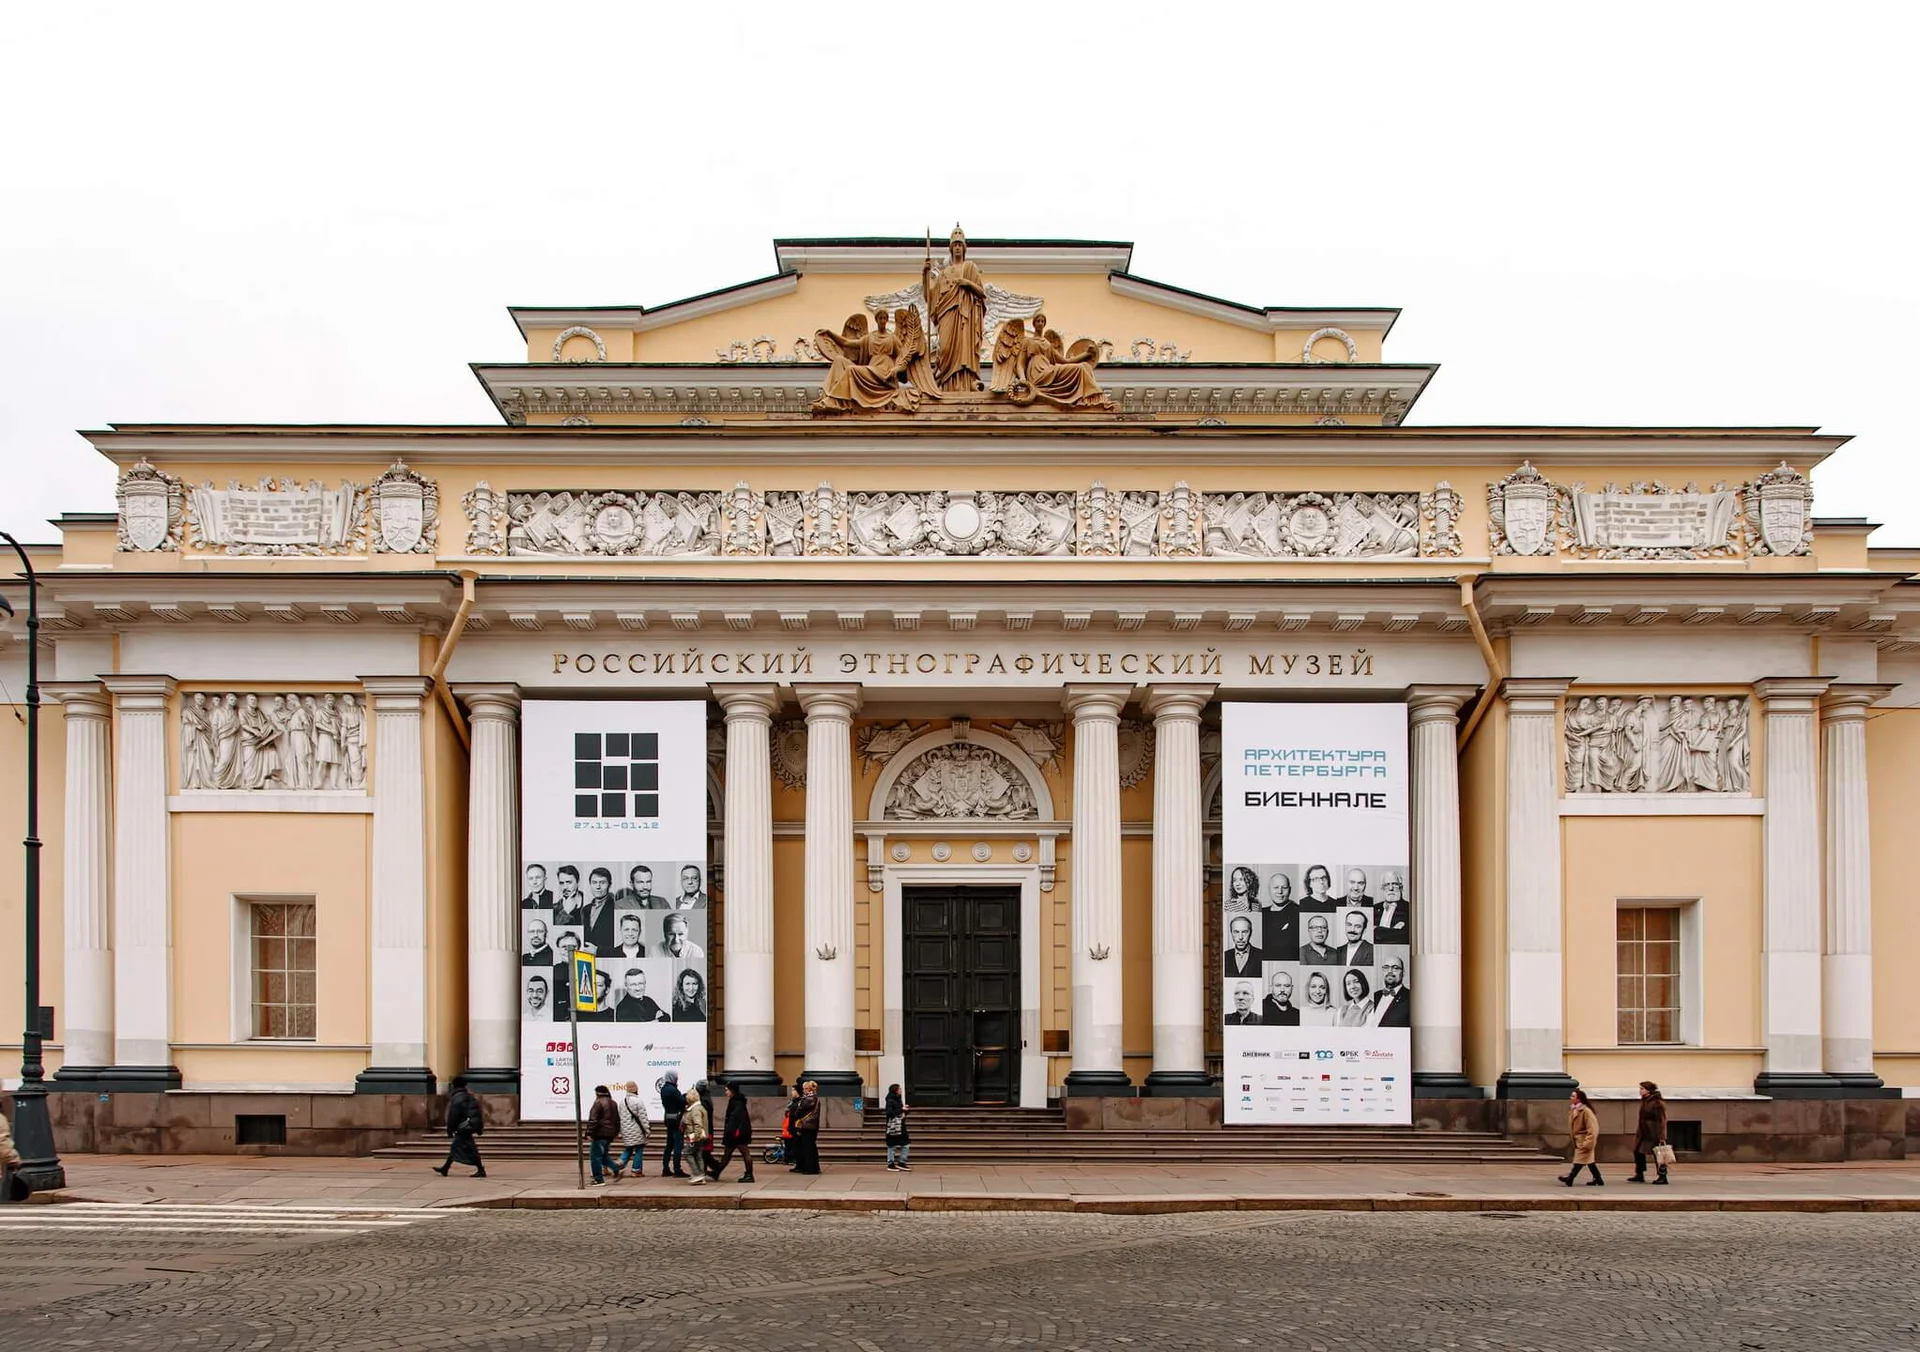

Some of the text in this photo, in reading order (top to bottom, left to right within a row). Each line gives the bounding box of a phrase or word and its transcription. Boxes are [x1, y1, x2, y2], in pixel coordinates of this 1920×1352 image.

[552, 647, 1374, 675] РОССИЙСКИЙ ЭТНОГРАФИЧЕСКИЙ МУЗЕЙ
[1244, 749, 1386, 762] АРХИТЕКТУРА
[1244, 764, 1386, 778] ПЕТЕРБУРГА
[1244, 791, 1387, 809] БИЕННАЛЕ
